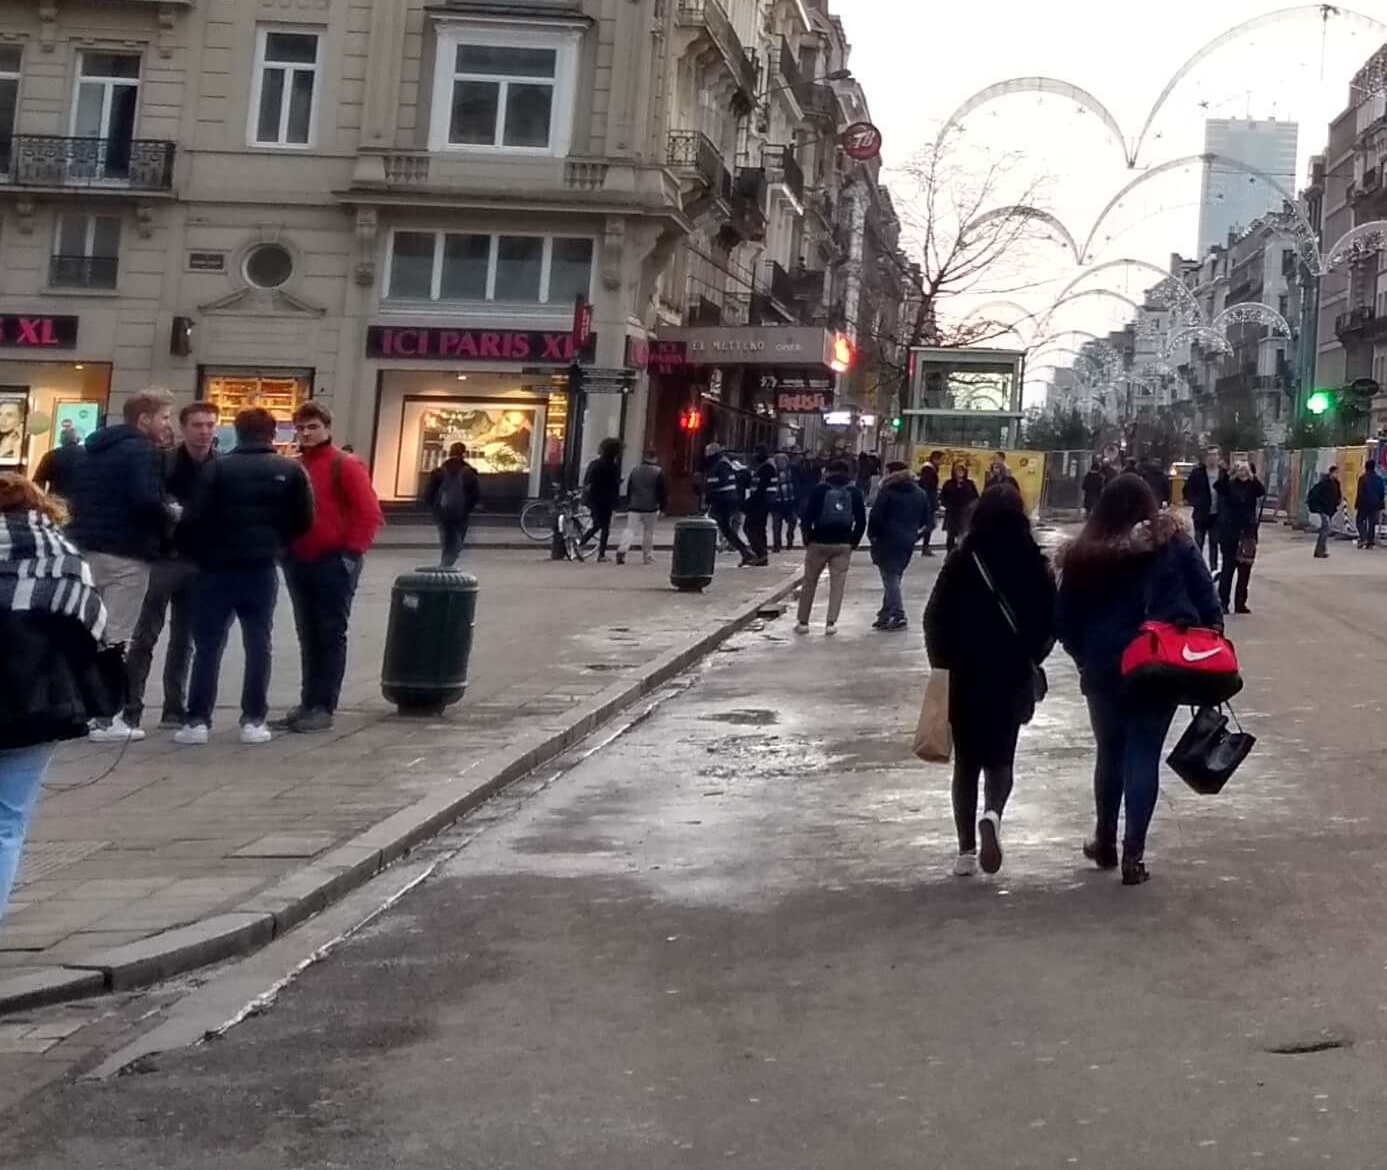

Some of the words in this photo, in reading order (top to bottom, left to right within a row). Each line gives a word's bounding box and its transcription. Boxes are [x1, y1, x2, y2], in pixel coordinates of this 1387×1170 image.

[16, 318, 58, 344] XL
[382, 330, 428, 354] ICI
[439, 332, 529, 358] PARIS
